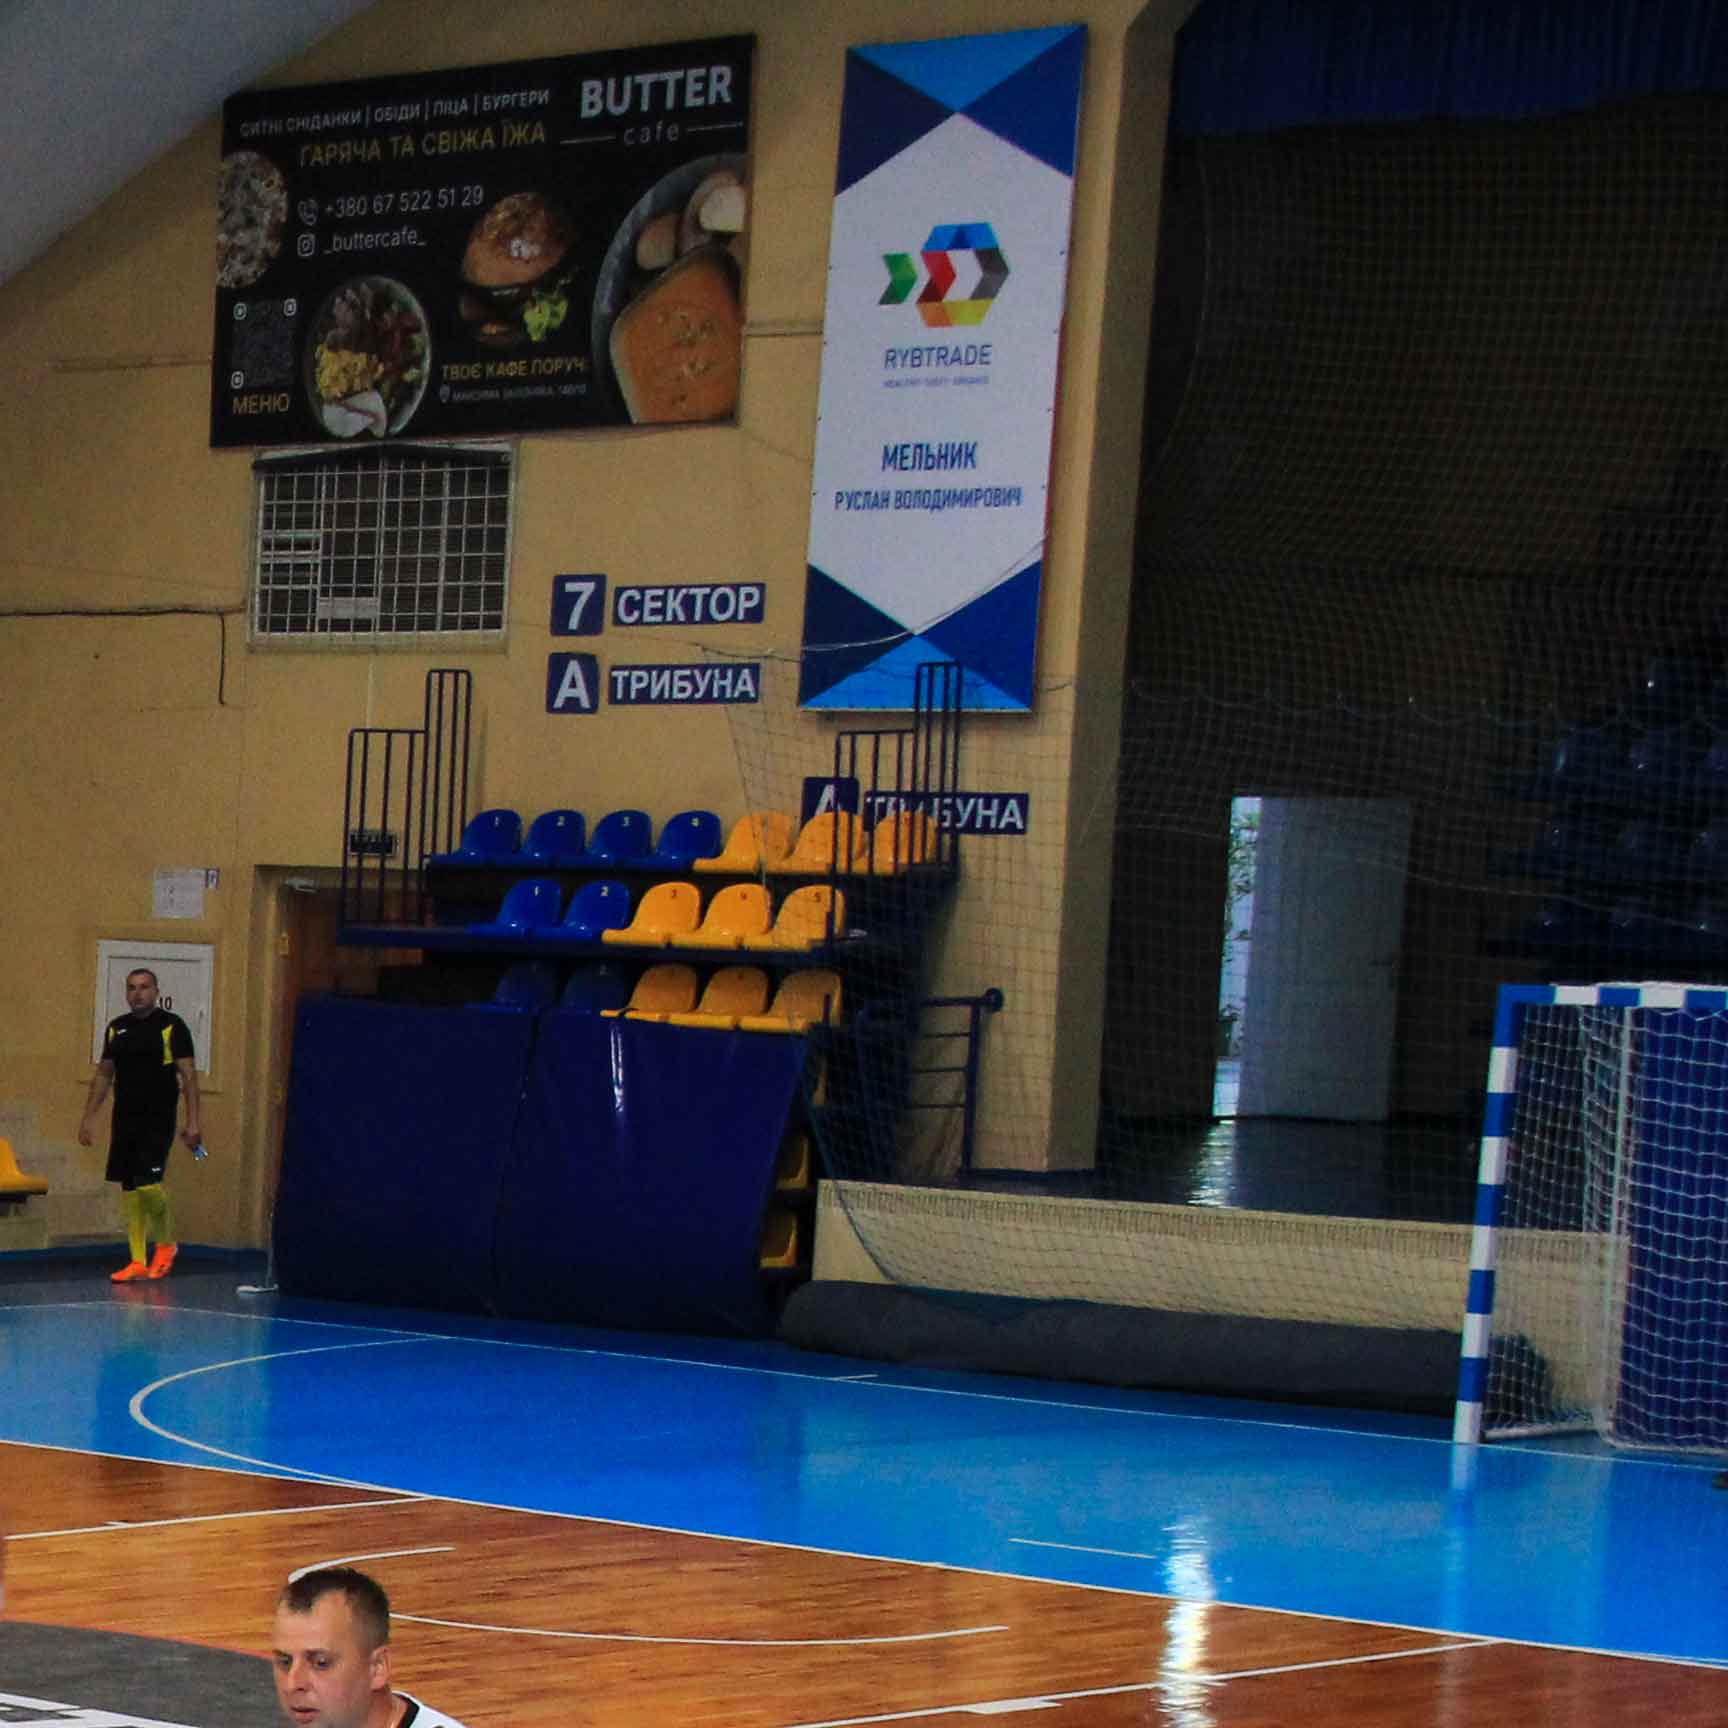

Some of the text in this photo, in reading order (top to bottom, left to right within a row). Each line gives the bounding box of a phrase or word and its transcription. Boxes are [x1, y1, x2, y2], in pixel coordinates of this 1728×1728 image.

[580, 64, 732, 119] BUTTER
[286, 110, 361, 134] СНІДАНКИ
[374, 103, 421, 125] ОБІДИ
[432, 98, 469, 119] ПІЦА
[481, 89, 550, 112] БУРГЕРИ
[299, 118, 546, 168] ГАРЯЧА ТА СВІЖА ЇЖА
[623, 120, 680, 145] cafe
[324, 195, 367, 219] +380
[372, 194, 393, 215] 67
[399, 190, 433, 213] 522
[436, 186, 456, 208] 51
[323, 225, 427, 256] _buttercafe_
[442, 356, 586, 381] ТВОЄ КАФЕ ПОРУЧ
[884, 344, 993, 369] RYBTRADE
[232, 392, 290, 415] МЕНЮ
[881, 441, 978, 472] МЕЛЬНИК
[834, 486, 1024, 514] РУСЛАН ВОЛОДИМИРОВИЧ
[564, 581, 597, 631] 7
[615, 587, 761, 625] СЕКТОР
[553, 659, 593, 710] А
[610, 667, 758, 702] ТРИБУНА
